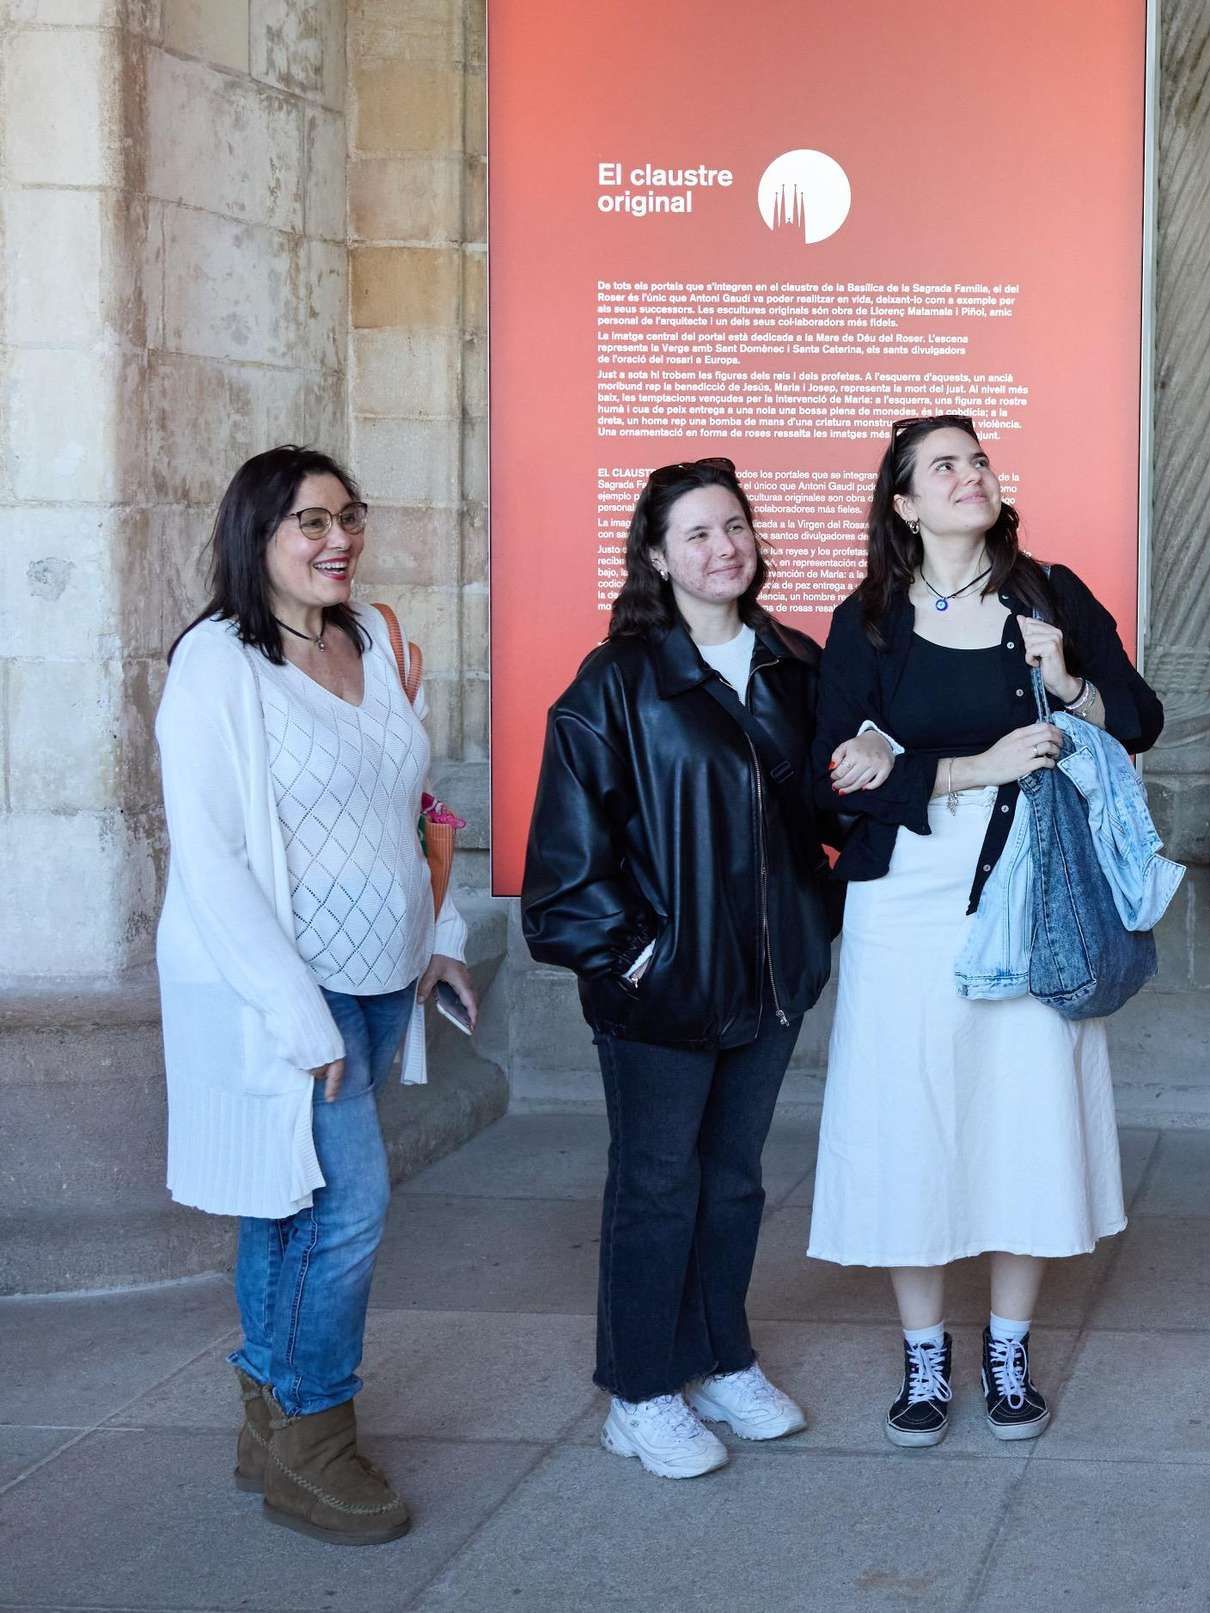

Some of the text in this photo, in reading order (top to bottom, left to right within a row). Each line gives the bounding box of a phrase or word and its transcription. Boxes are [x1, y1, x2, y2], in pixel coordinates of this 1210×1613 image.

[598, 163, 734, 187] El claustre
[597, 191, 693, 217] original
[598, 281, 612, 290] De
[613, 281, 632, 290] tots
[634, 281, 649, 291] els
[651, 281, 684, 292] portals
[686, 284, 704, 292] que
[770, 282, 779, 291] el
[781, 282, 819, 292] claustre
[821, 283, 834, 292] de
[836, 283, 845, 292] la
[886, 283, 899, 292] de
[901, 283, 910, 293] la
[912, 283, 952, 294] Sagrada
[992, 284, 1002, 294] el
[1004, 284, 1020, 294] del
[598, 293, 625, 302] Roser
[627, 293, 640, 302] és
[669, 295, 688, 304] que
[690, 293, 720, 303] Antoni
[722, 293, 751, 303] Gaudí
[753, 295, 764, 303] va
[766, 294, 794, 304] poder
[796, 294, 835, 303] realitzar
[837, 296, 849, 304] en
[851, 295, 874, 305] vida,
[925, 297, 946, 305] com
[956, 295, 997, 306] exemple
[999, 297, 1016, 306] per
[597, 304, 612, 313] als
[639, 306, 695, 314] successors.
[698, 305, 715, 314] Les
[717, 305, 766, 314] escultures
[768, 306, 809, 316] originals
[812, 306, 829, 315] són
[831, 306, 853, 315] obra
[855, 306, 868, 315] de
[989, 307, 1012, 317] amic
[598, 331, 609, 340] La
[612, 331, 644, 342] imatge
[646, 332, 679, 340] central
[681, 332, 696, 341] del
[698, 332, 726, 342] portal
[751, 332, 794, 342] dedicada
[805, 333, 814, 342] la
[816, 333, 840, 342] Mare
[842, 333, 854, 342] de
[857, 333, 876, 342] Déu
[878, 333, 894, 343] del
[896, 333, 926, 343] Roser.
[598, 343, 648, 353] representa
[651, 343, 660, 352] la
[662, 343, 690, 354] Verge
[692, 344, 713, 352] amb
[715, 344, 738, 353] Sant
[792, 344, 820, 353] Santa
[822, 344, 864, 355] Caterina,
[866, 345, 881, 354] els
[883, 345, 909, 354] sants
[911, 345, 966, 356] divulgadors
[598, 354, 610, 363] de
[649, 354, 664, 364] del
[666, 355, 693, 364] rosari
[704, 355, 741, 366] Europa.
[598, 468, 610, 477] EL
[760, 470, 773, 479] los
[775, 470, 810, 480] portales
[811, 472, 829, 481] que
[843, 470, 878, 481] integran
[598, 479, 635, 491] Sagrada
[744, 481, 752, 490] el
[754, 481, 778, 490] único
[779, 483, 796, 492] que
[798, 481, 826, 491] Antoni
[598, 491, 632, 502] ejemplo
[784, 493, 826, 504] originales
[846, 493, 866, 503] obra
[598, 503, 635, 513] personal
[754, 504, 816, 513] colaboradores
[598, 518, 609, 527] La
[788, 519, 796, 528] la
[798, 519, 825, 531] Virgen
[827, 520, 841, 529] del
[597, 545, 621, 554] Justo
[785, 548, 809, 557] reyes
[810, 548, 816, 558] y
[818, 546, 831, 556] los
[598, 567, 619, 578] bajo,
